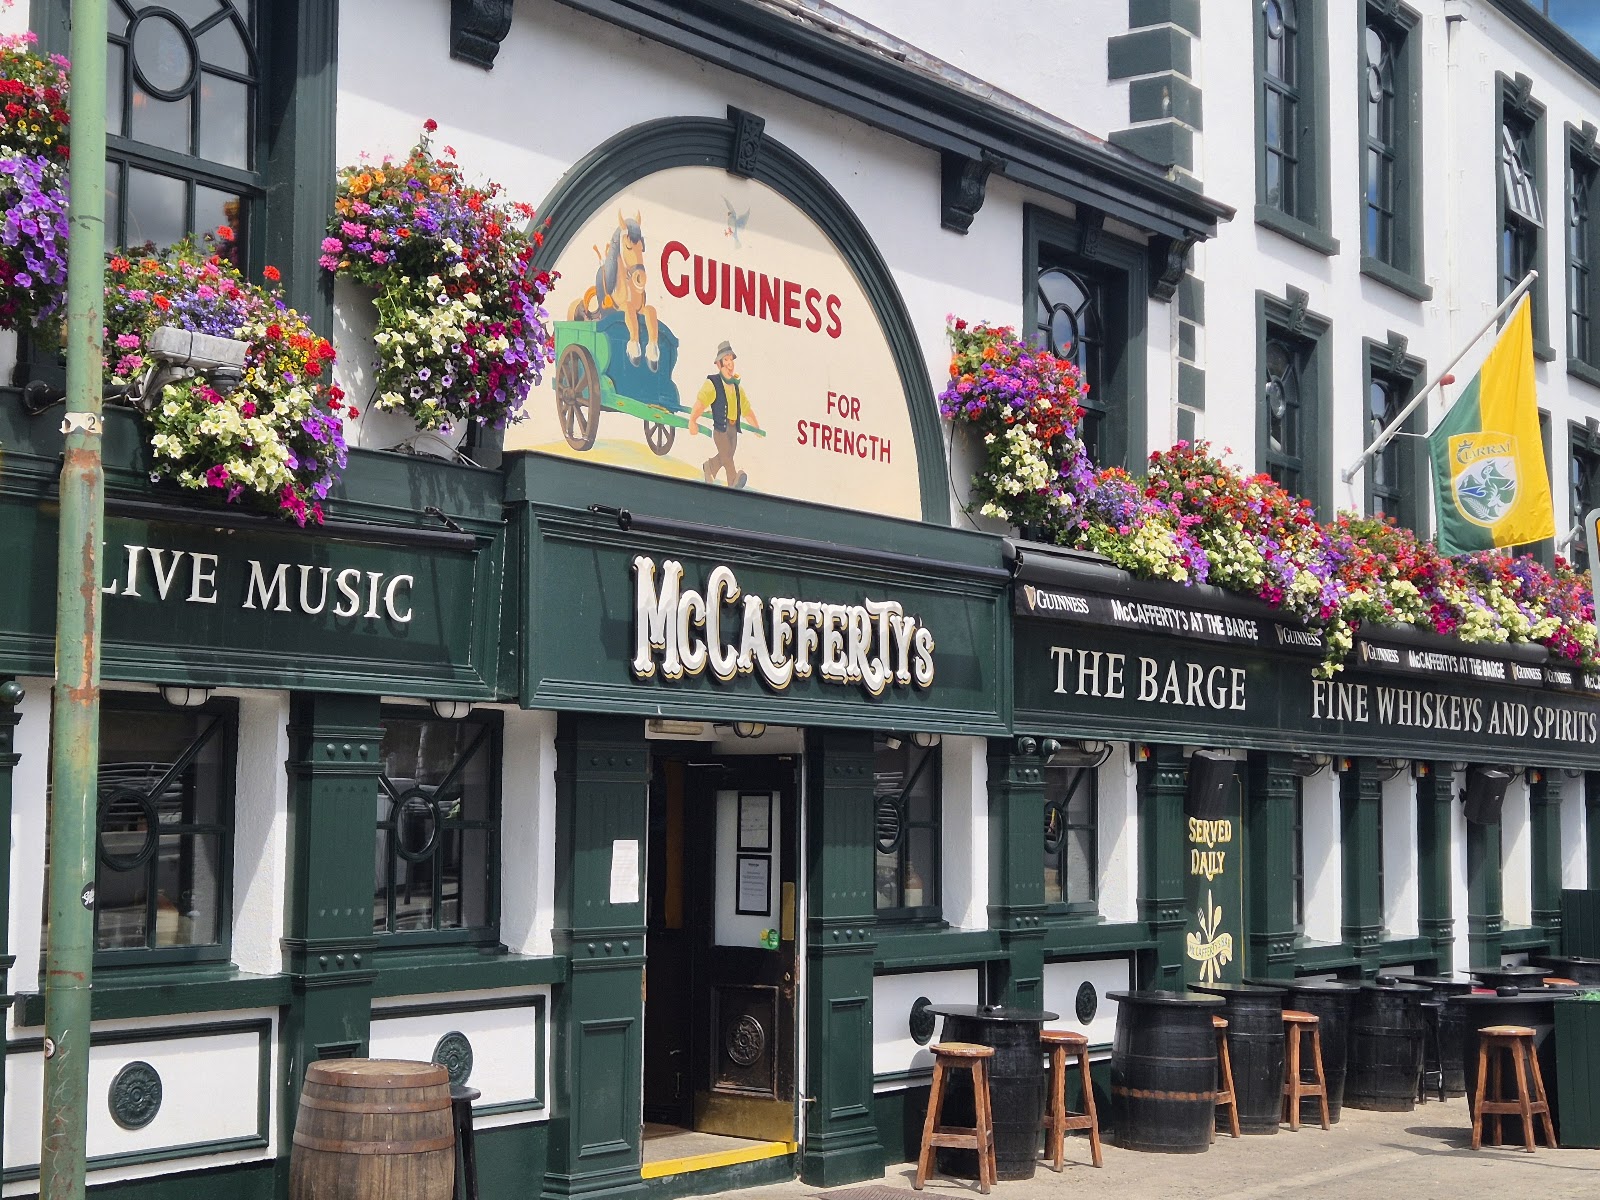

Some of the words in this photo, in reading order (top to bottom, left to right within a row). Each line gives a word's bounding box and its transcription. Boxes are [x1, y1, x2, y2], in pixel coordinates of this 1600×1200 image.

[660, 240, 842, 339] GUINNESS
[826, 391, 861, 421] FOR
[87, 415, 96, 431] 2
[796, 419, 891, 464] STRENGTH
[241, 559, 414, 623] MUSIC
[1036, 589, 1090, 615] GUINNESS
[1111, 598, 1189, 631] McCAFFERTY'S
[1190, 611, 1204, 633] AT
[1204, 612, 1226, 636] THE
[1224, 616, 1259, 641] BARGE
[1367, 643, 1400, 664] GUINNESS
[1408, 650, 1458, 673] McCAFFERTY'S
[1459, 656, 1468, 674] AT
[1468, 657, 1483, 676] THE
[1481, 659, 1506, 680] BARGE
[1050, 645, 1126, 699] THE
[1137, 656, 1247, 711] BARGE
[1516, 664, 1542, 680] GUINNESS
[1311, 679, 1369, 723] FINE
[1376, 685, 1483, 733] WHISKEYS
[1488, 701, 1529, 737] AND
[1533, 705, 1597, 744] SPIRITS
[1188, 816, 1232, 849] SERVED
[1190, 848, 1226, 882] DAILY
